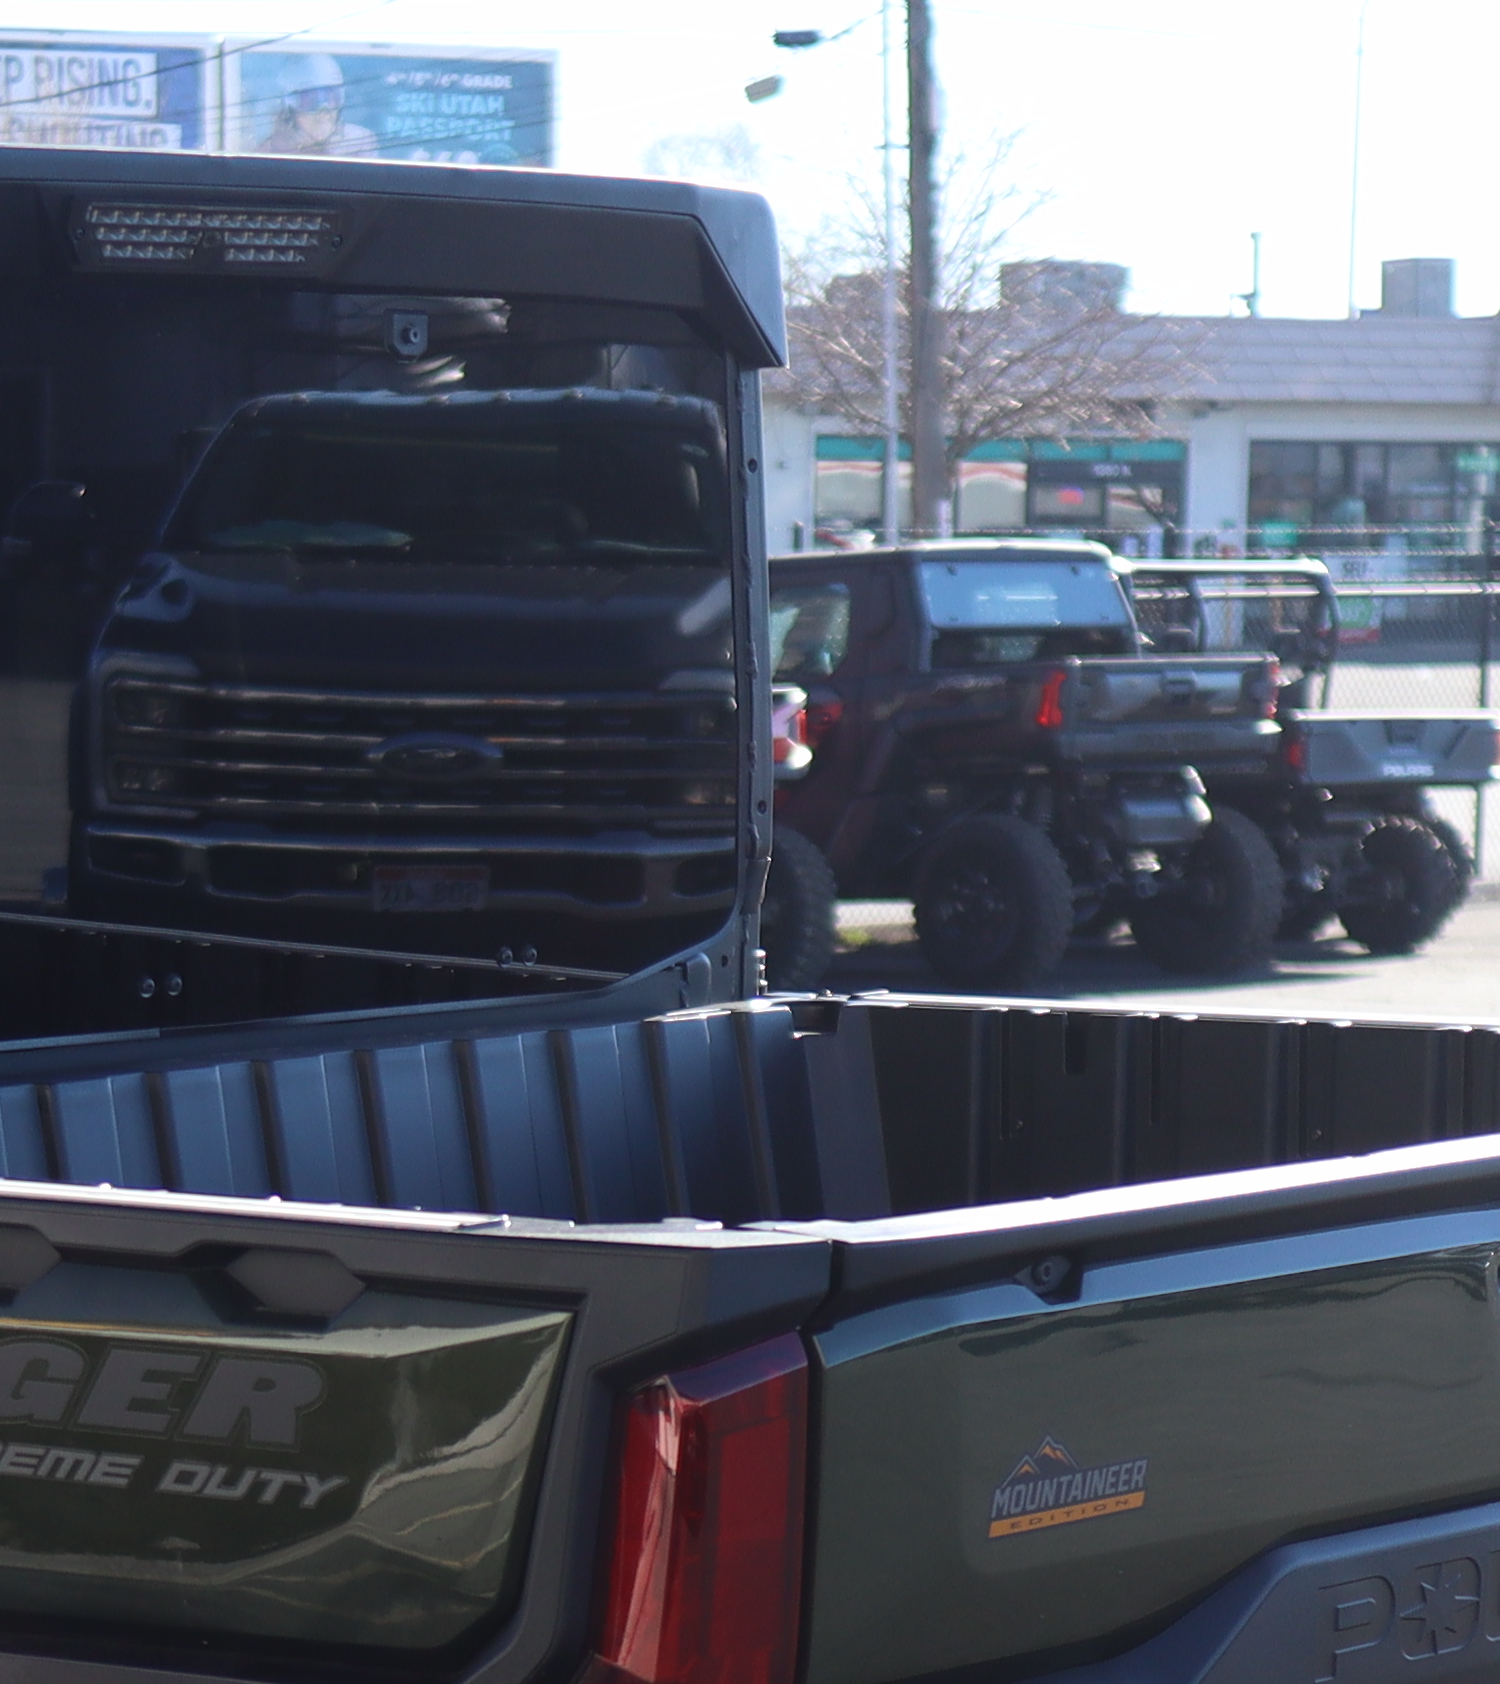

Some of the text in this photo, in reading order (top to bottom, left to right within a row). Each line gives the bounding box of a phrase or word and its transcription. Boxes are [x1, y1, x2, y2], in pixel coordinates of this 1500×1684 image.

[462, 73, 513, 89] GRADE
[395, 92, 506, 115] SKI UTAH
[155, 1461, 350, 1509] DUTY
[990, 1458, 1149, 1519] MOUNTAINEER
[1009, 1498, 1130, 1530] EDITION
